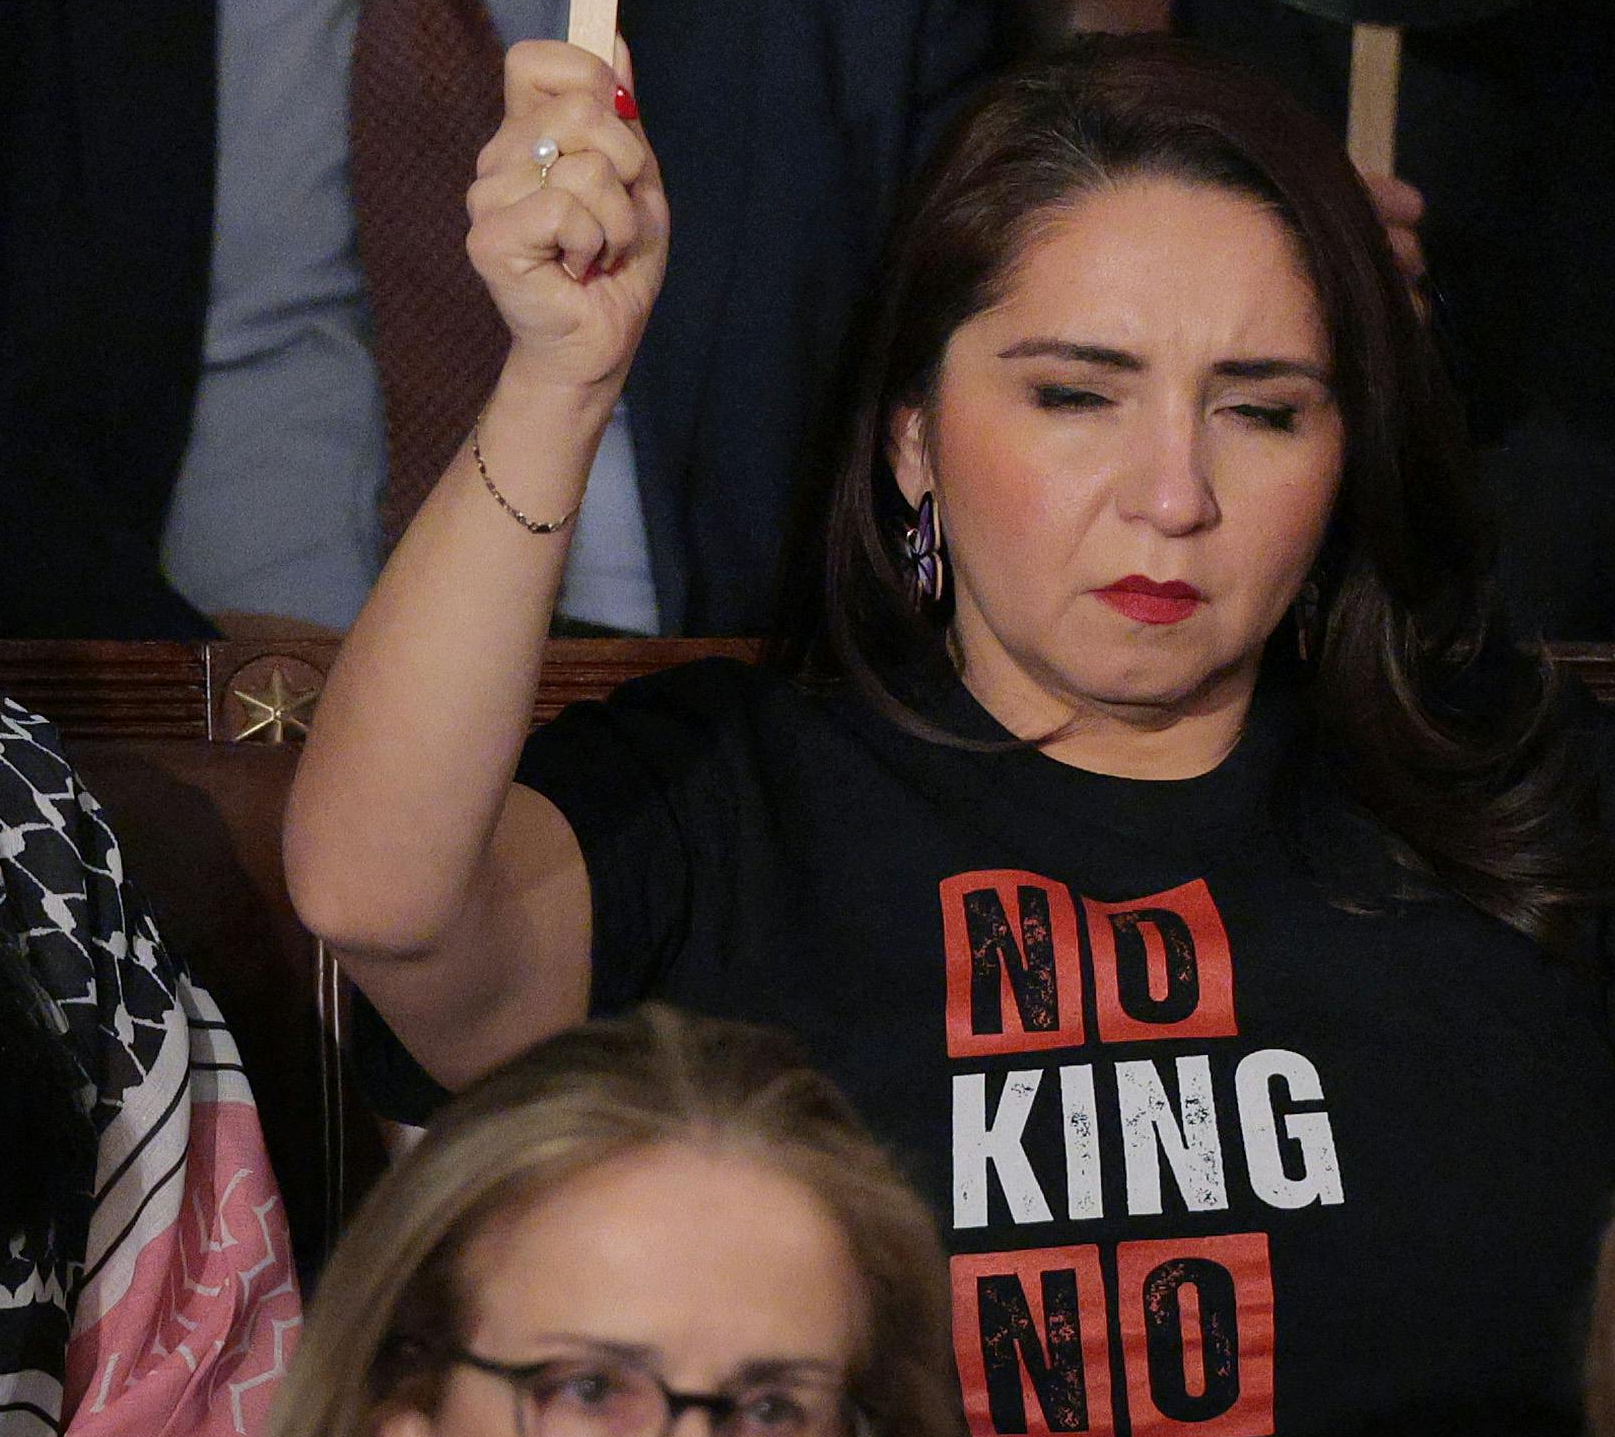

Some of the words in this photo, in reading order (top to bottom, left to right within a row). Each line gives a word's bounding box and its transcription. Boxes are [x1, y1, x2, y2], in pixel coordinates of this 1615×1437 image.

[961, 883, 1202, 1036] NO
[951, 1047, 1346, 1231] KING
[975, 1256, 1241, 1436] NO
